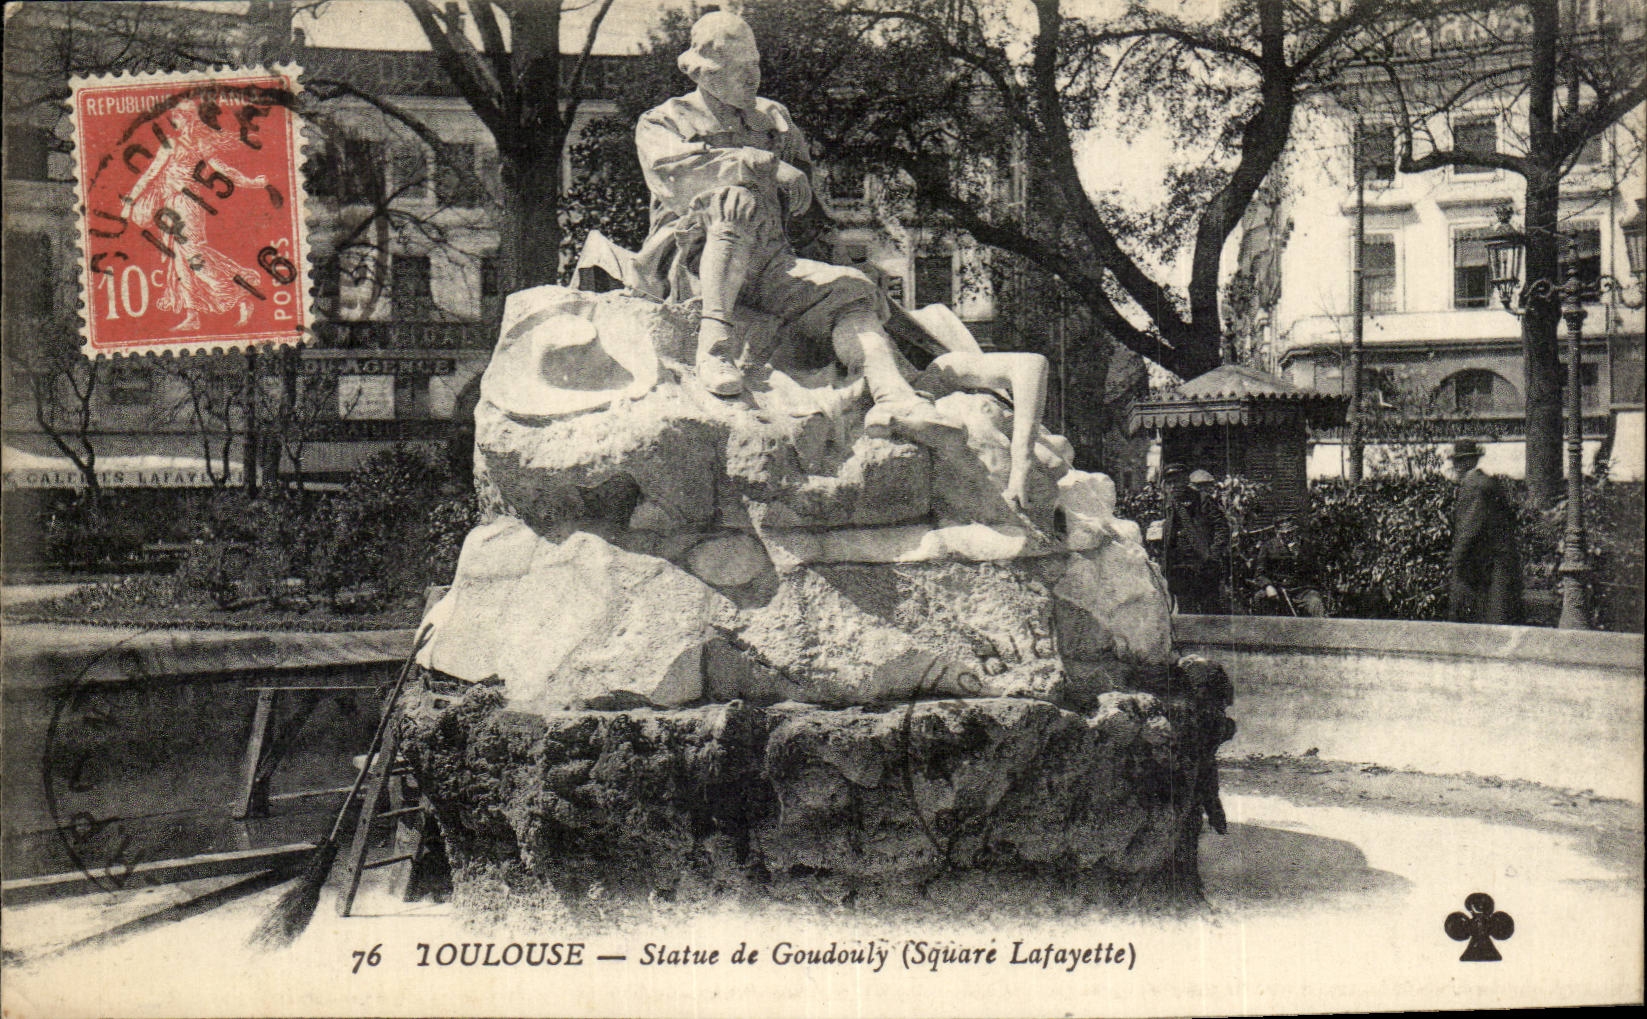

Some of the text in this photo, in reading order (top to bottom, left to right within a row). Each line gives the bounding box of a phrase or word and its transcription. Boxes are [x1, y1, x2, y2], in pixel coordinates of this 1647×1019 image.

[342, 359, 449, 375] AGENCE
[26, 471, 124, 485] GALERES
[137, 471, 244, 485] LAFAYE
